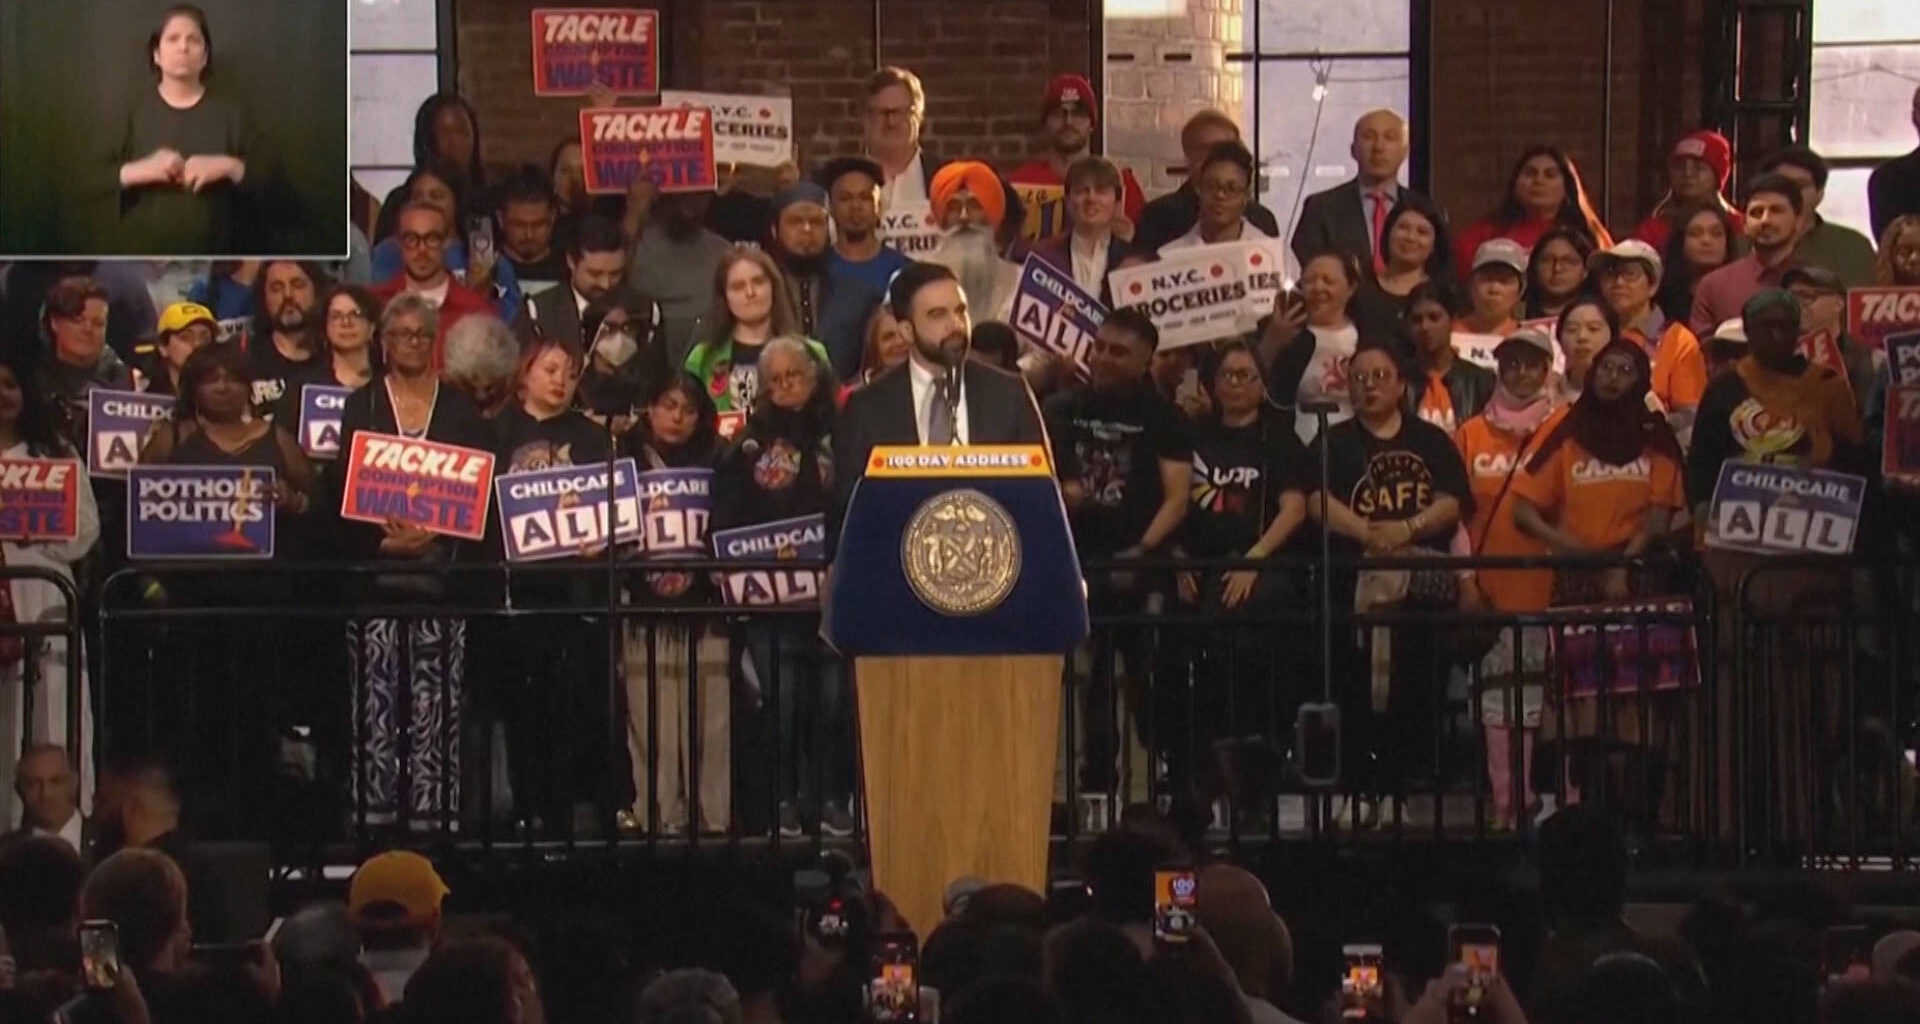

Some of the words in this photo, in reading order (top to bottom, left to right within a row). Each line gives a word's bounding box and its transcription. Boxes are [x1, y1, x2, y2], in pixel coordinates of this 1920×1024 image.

[544, 14, 653, 43] TACKLE
[592, 110, 705, 141] TACKLE
[1128, 280, 1247, 318] ROCERIES
[363, 439, 487, 483] TACKLE
[888, 456, 914, 467] 100
[918, 455, 950, 467] DAY
[955, 454, 1030, 467] ADDRESS
[1358, 482, 1430, 513] SAFE
[1732, 471, 1849, 501] CHILDCARE
[139, 501, 264, 522] POLITICS
[356, 486, 473, 531] WASTE
[521, 502, 629, 547] ALL
[1726, 505, 1839, 549] ALL
